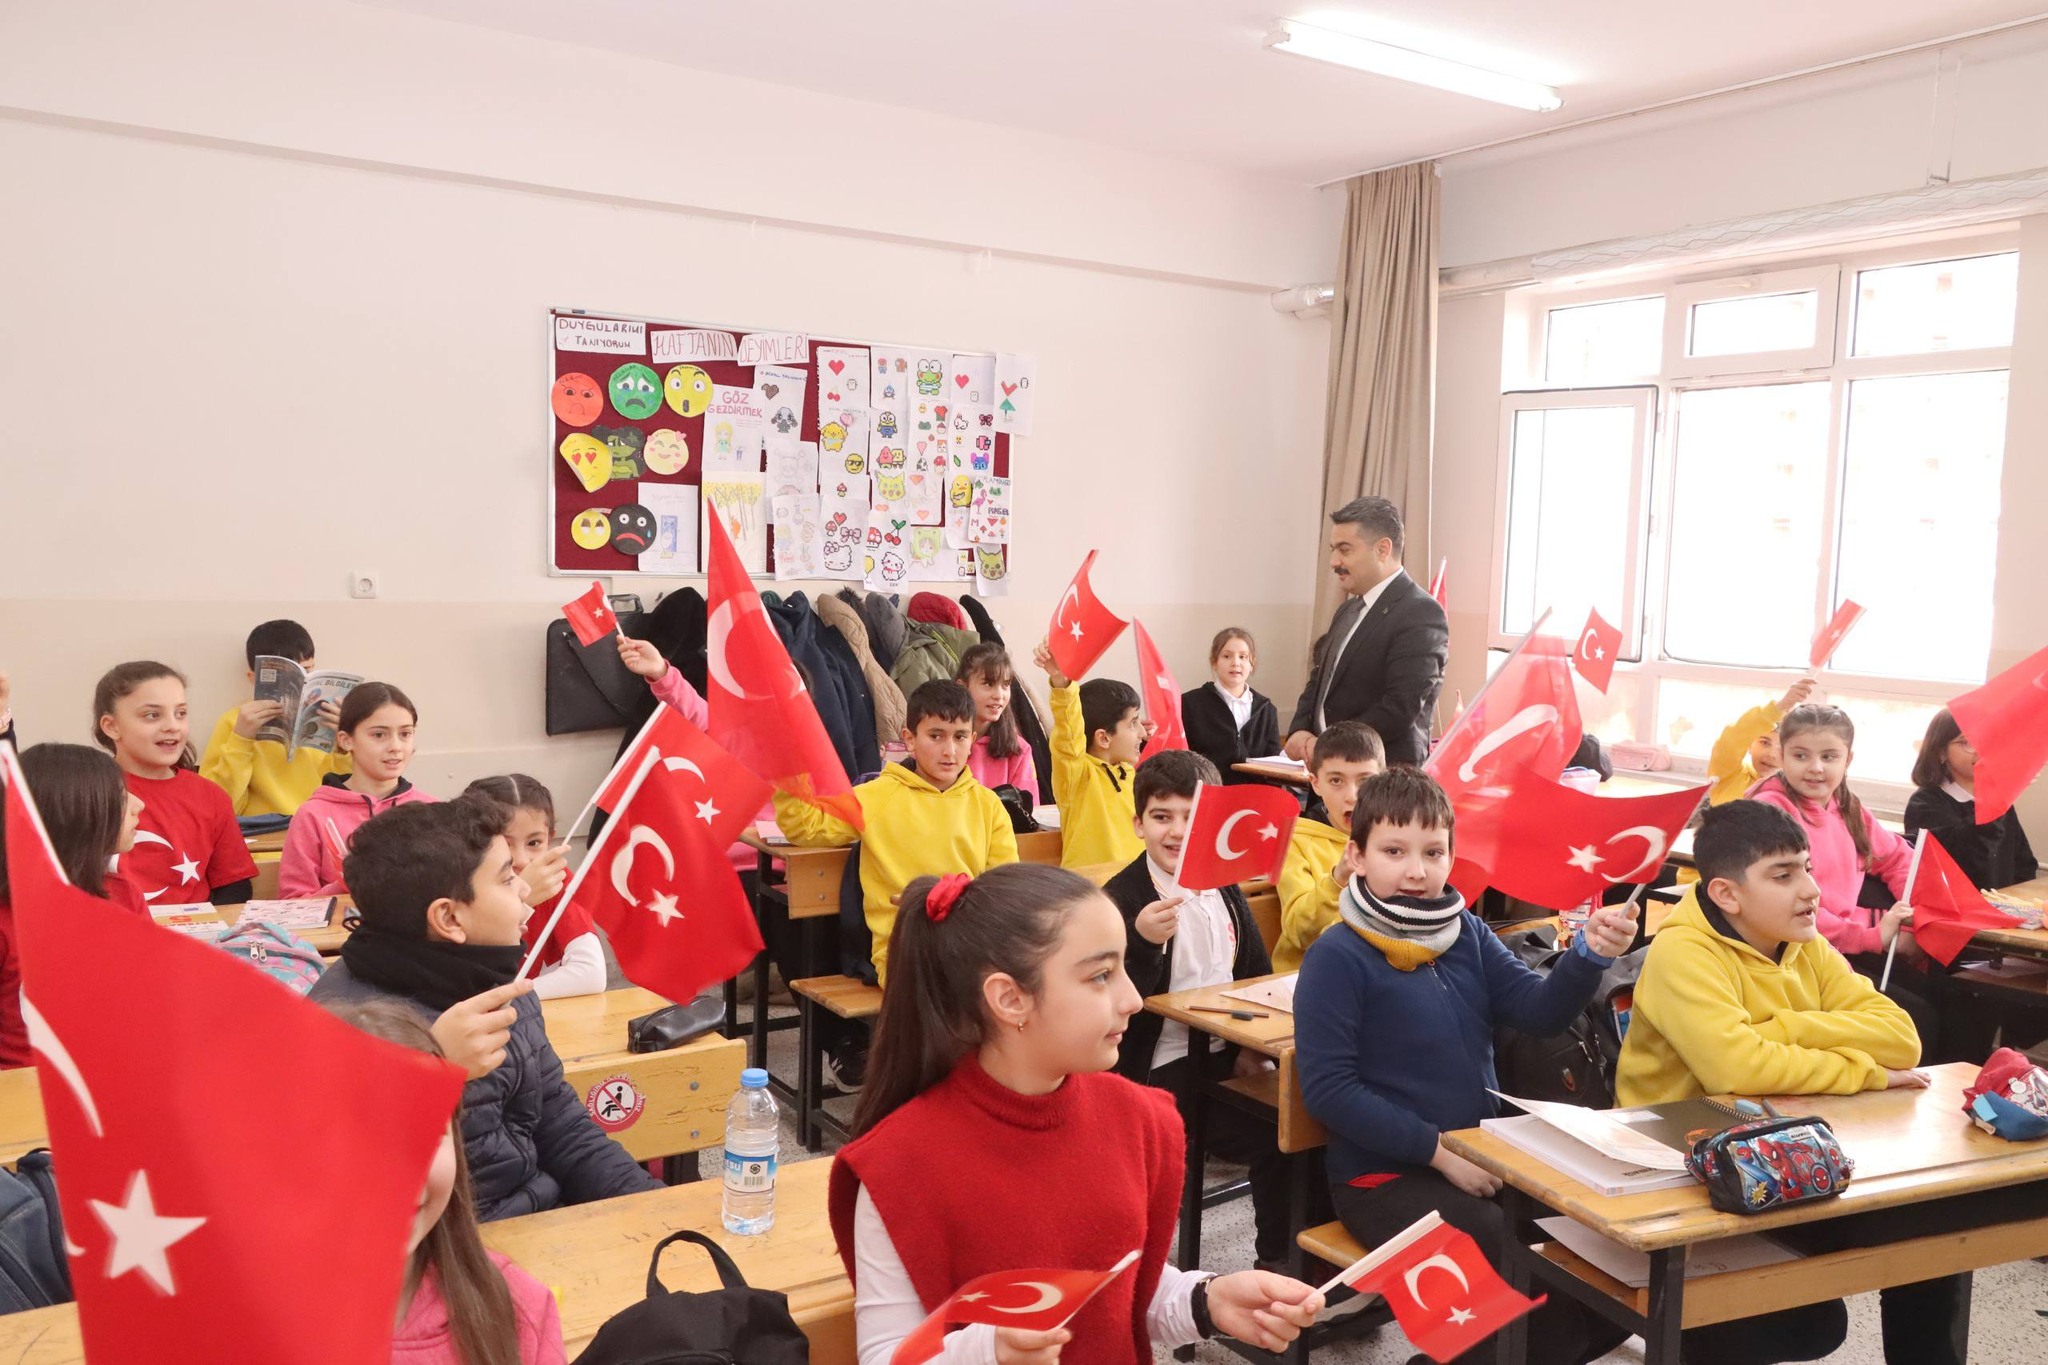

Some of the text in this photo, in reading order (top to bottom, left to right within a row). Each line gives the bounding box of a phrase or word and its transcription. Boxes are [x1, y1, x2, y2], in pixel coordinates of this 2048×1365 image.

[575, 335, 631, 349] TANIYORUM
[653, 331, 734, 357] HAFTANIN
[722, 391, 750, 405] GÖZ
[707, 404, 763, 418] GEZDİRMEK
